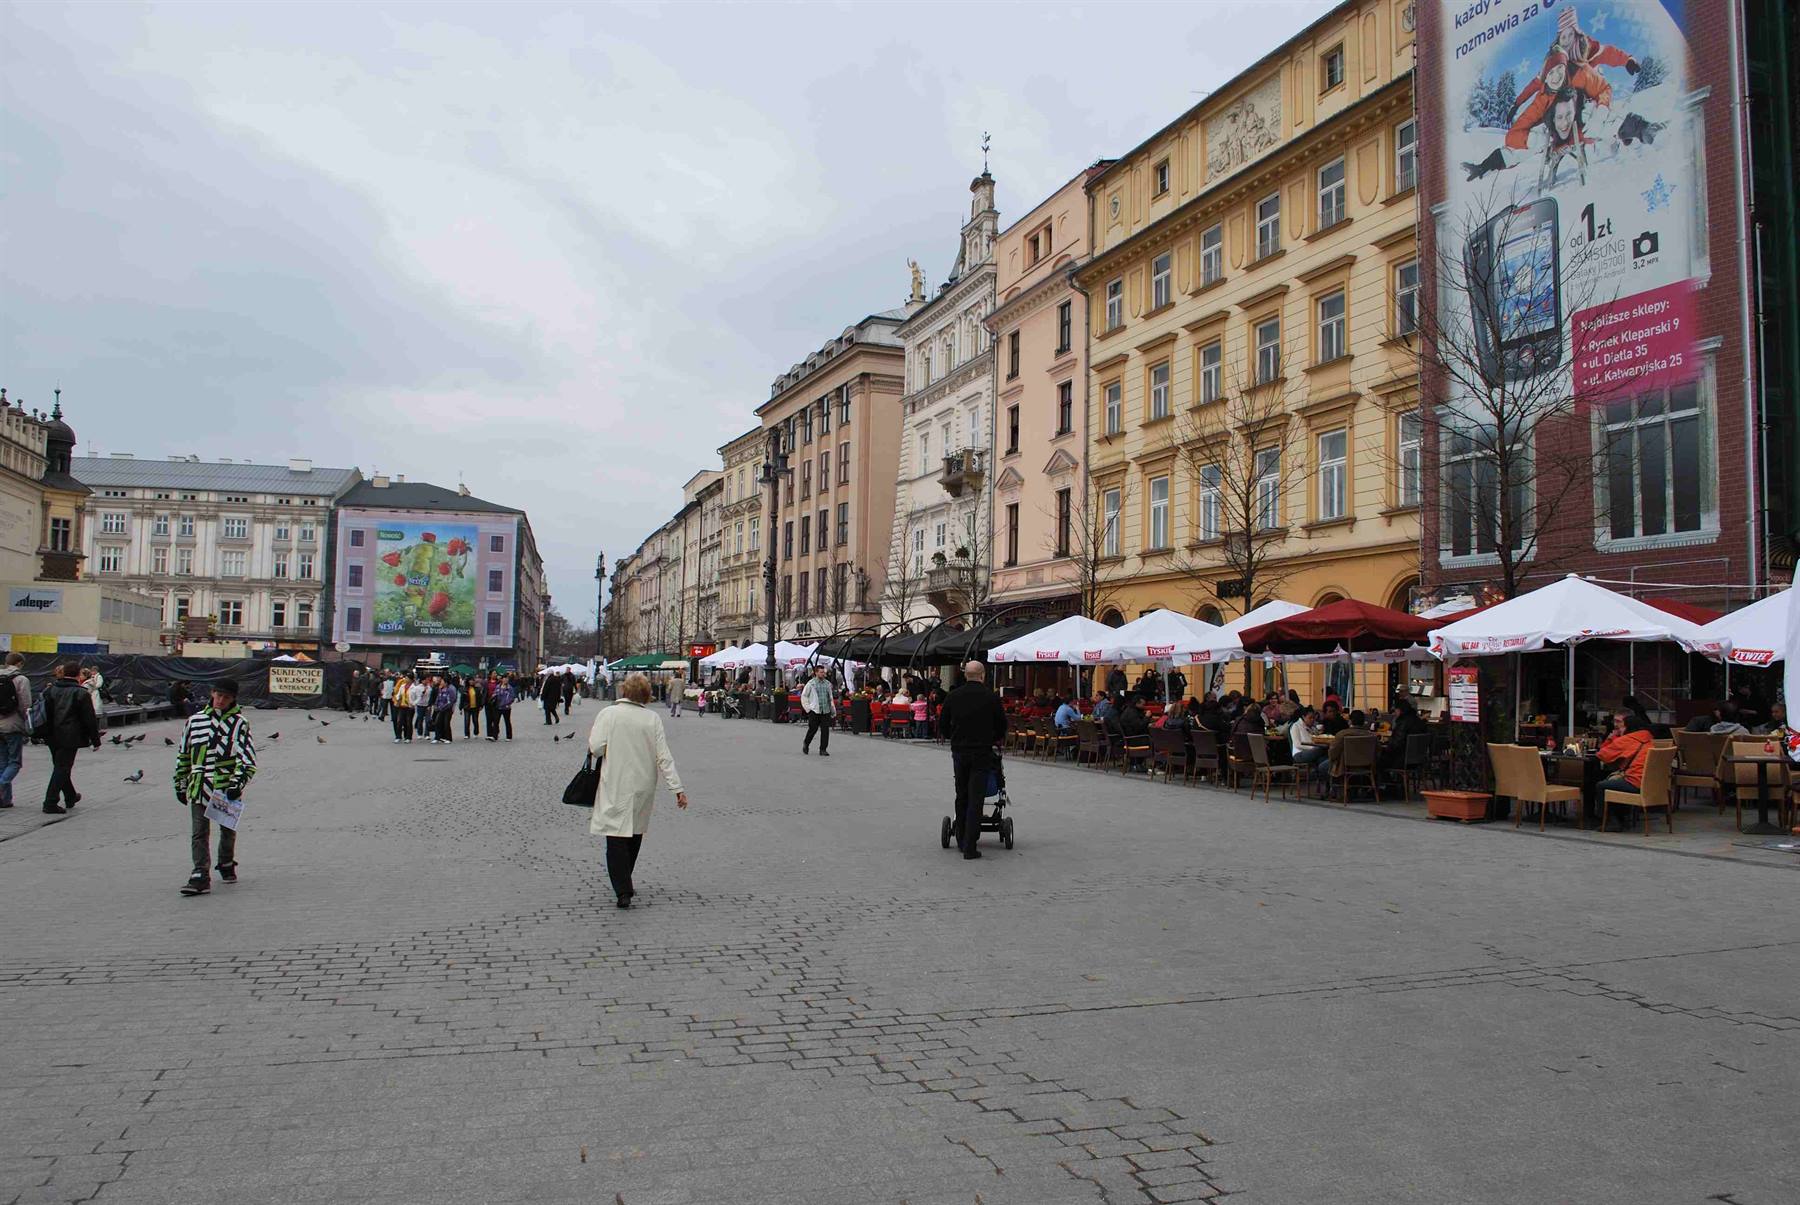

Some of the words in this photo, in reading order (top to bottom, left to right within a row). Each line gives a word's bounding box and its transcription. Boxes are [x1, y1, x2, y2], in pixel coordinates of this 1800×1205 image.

[1455, 0, 1491, 29] każdy
[1456, 14, 1519, 59] rozmawia
[1523, 4, 1539, 22] za
[1570, 232, 1583, 248] od
[1570, 239, 1625, 269] SAMSUNG
[1633, 258, 1646, 270] 3,2
[1580, 311, 1630, 333] Najbliższe
[1632, 300, 1670, 318] sklepy:
[1588, 335, 1619, 352] Rynek
[1621, 319, 1671, 342] Kleparski
[1673, 318, 1680, 330] 9
[1589, 357, 1602, 369] ul.
[1604, 350, 1633, 366] Dietla
[1635, 344, 1648, 358] 35
[1590, 372, 1602, 386] ul.
[1604, 359, 1667, 383] Kalwaryjska
[1669, 353, 1683, 368] 25
[378, 623, 404, 632] NESTEA
[430, 627, 471, 635] truskawkowo
[1037, 651, 1059, 659] TYSKIE
[1084, 651, 1101, 660] TYSKIE
[1147, 645, 1173, 656] TYSKIE
[271, 669, 321, 677] SUKIENNICE
